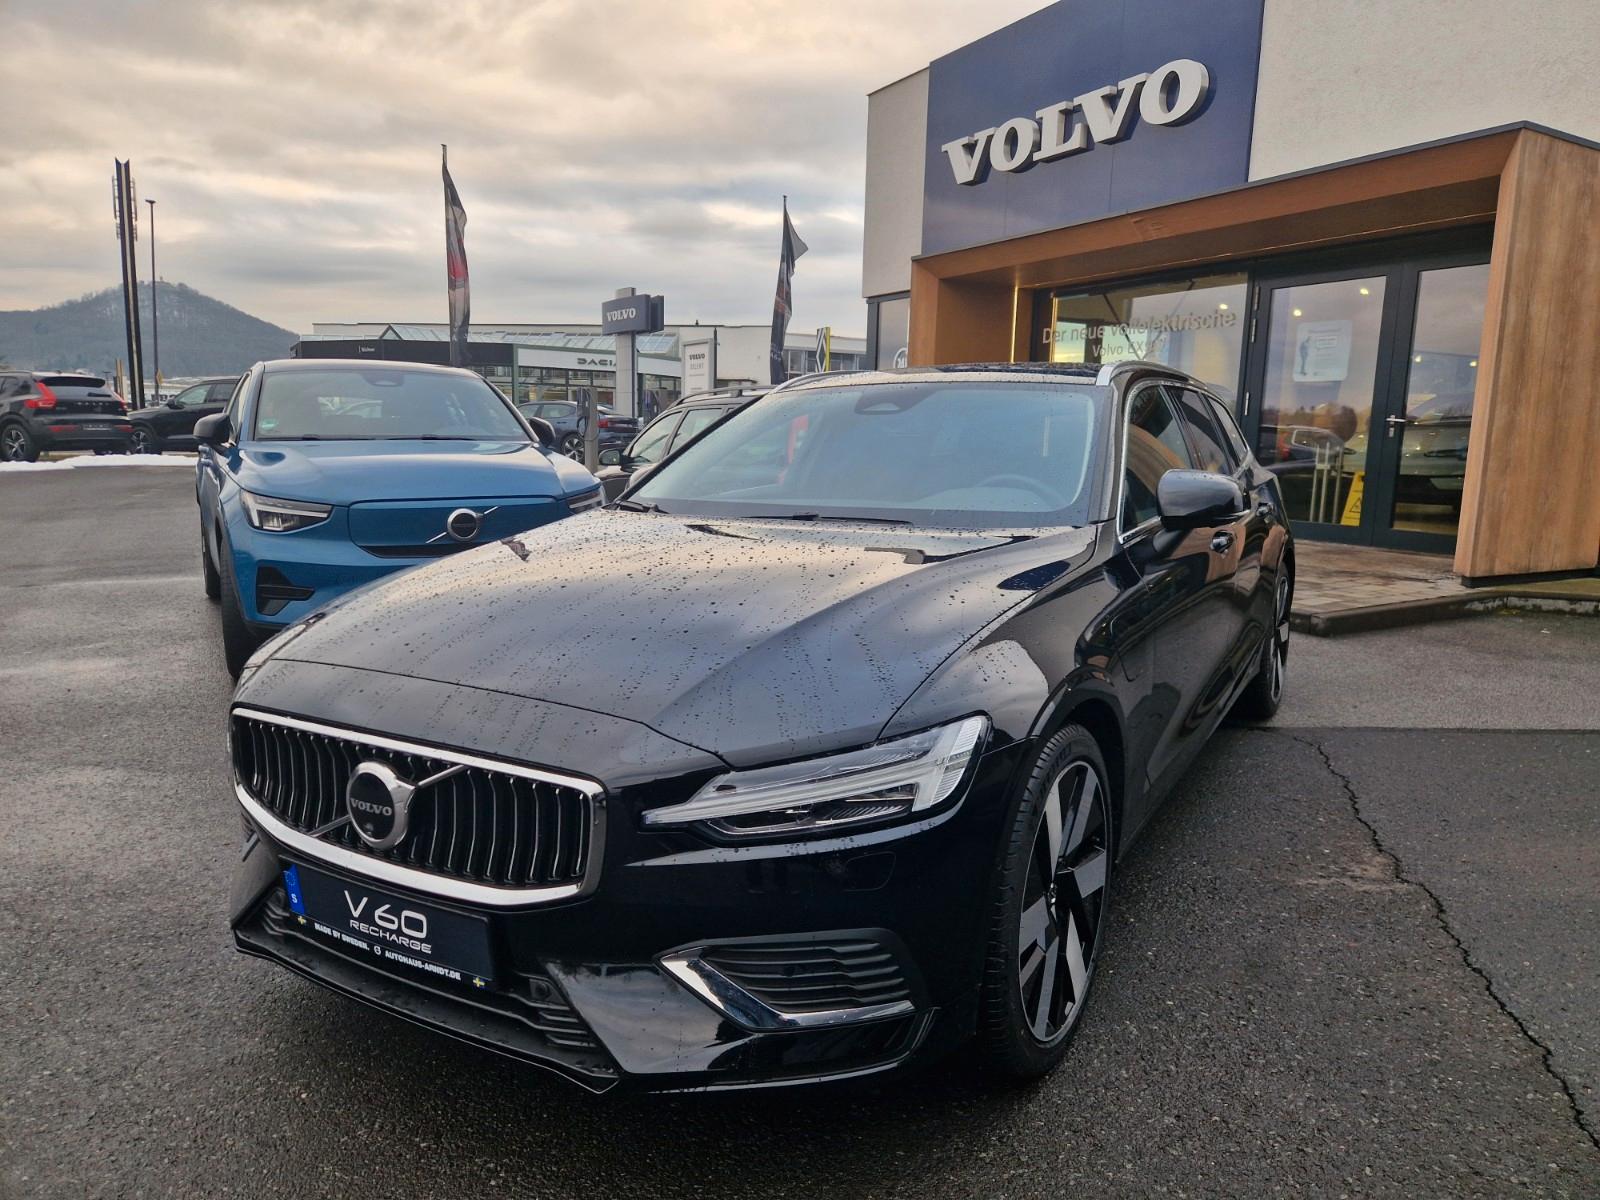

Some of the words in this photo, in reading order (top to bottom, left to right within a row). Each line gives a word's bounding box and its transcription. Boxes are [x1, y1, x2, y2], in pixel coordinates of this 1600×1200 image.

[941, 58, 1212, 186] VOLVO
[606, 307, 636, 322] VOLVO
[1042, 327, 1067, 344] Der
[1071, 324, 1105, 341] neue
[1092, 343, 1124, 357] Volvo
[349, 797, 393, 816] VOLVO
[290, 893, 298, 904] S
[349, 919, 432, 954] RECHARGE
[332, 930, 341, 940] BY
[384, 950, 462, 982] AUTOHAUS-ARNDT.DE
